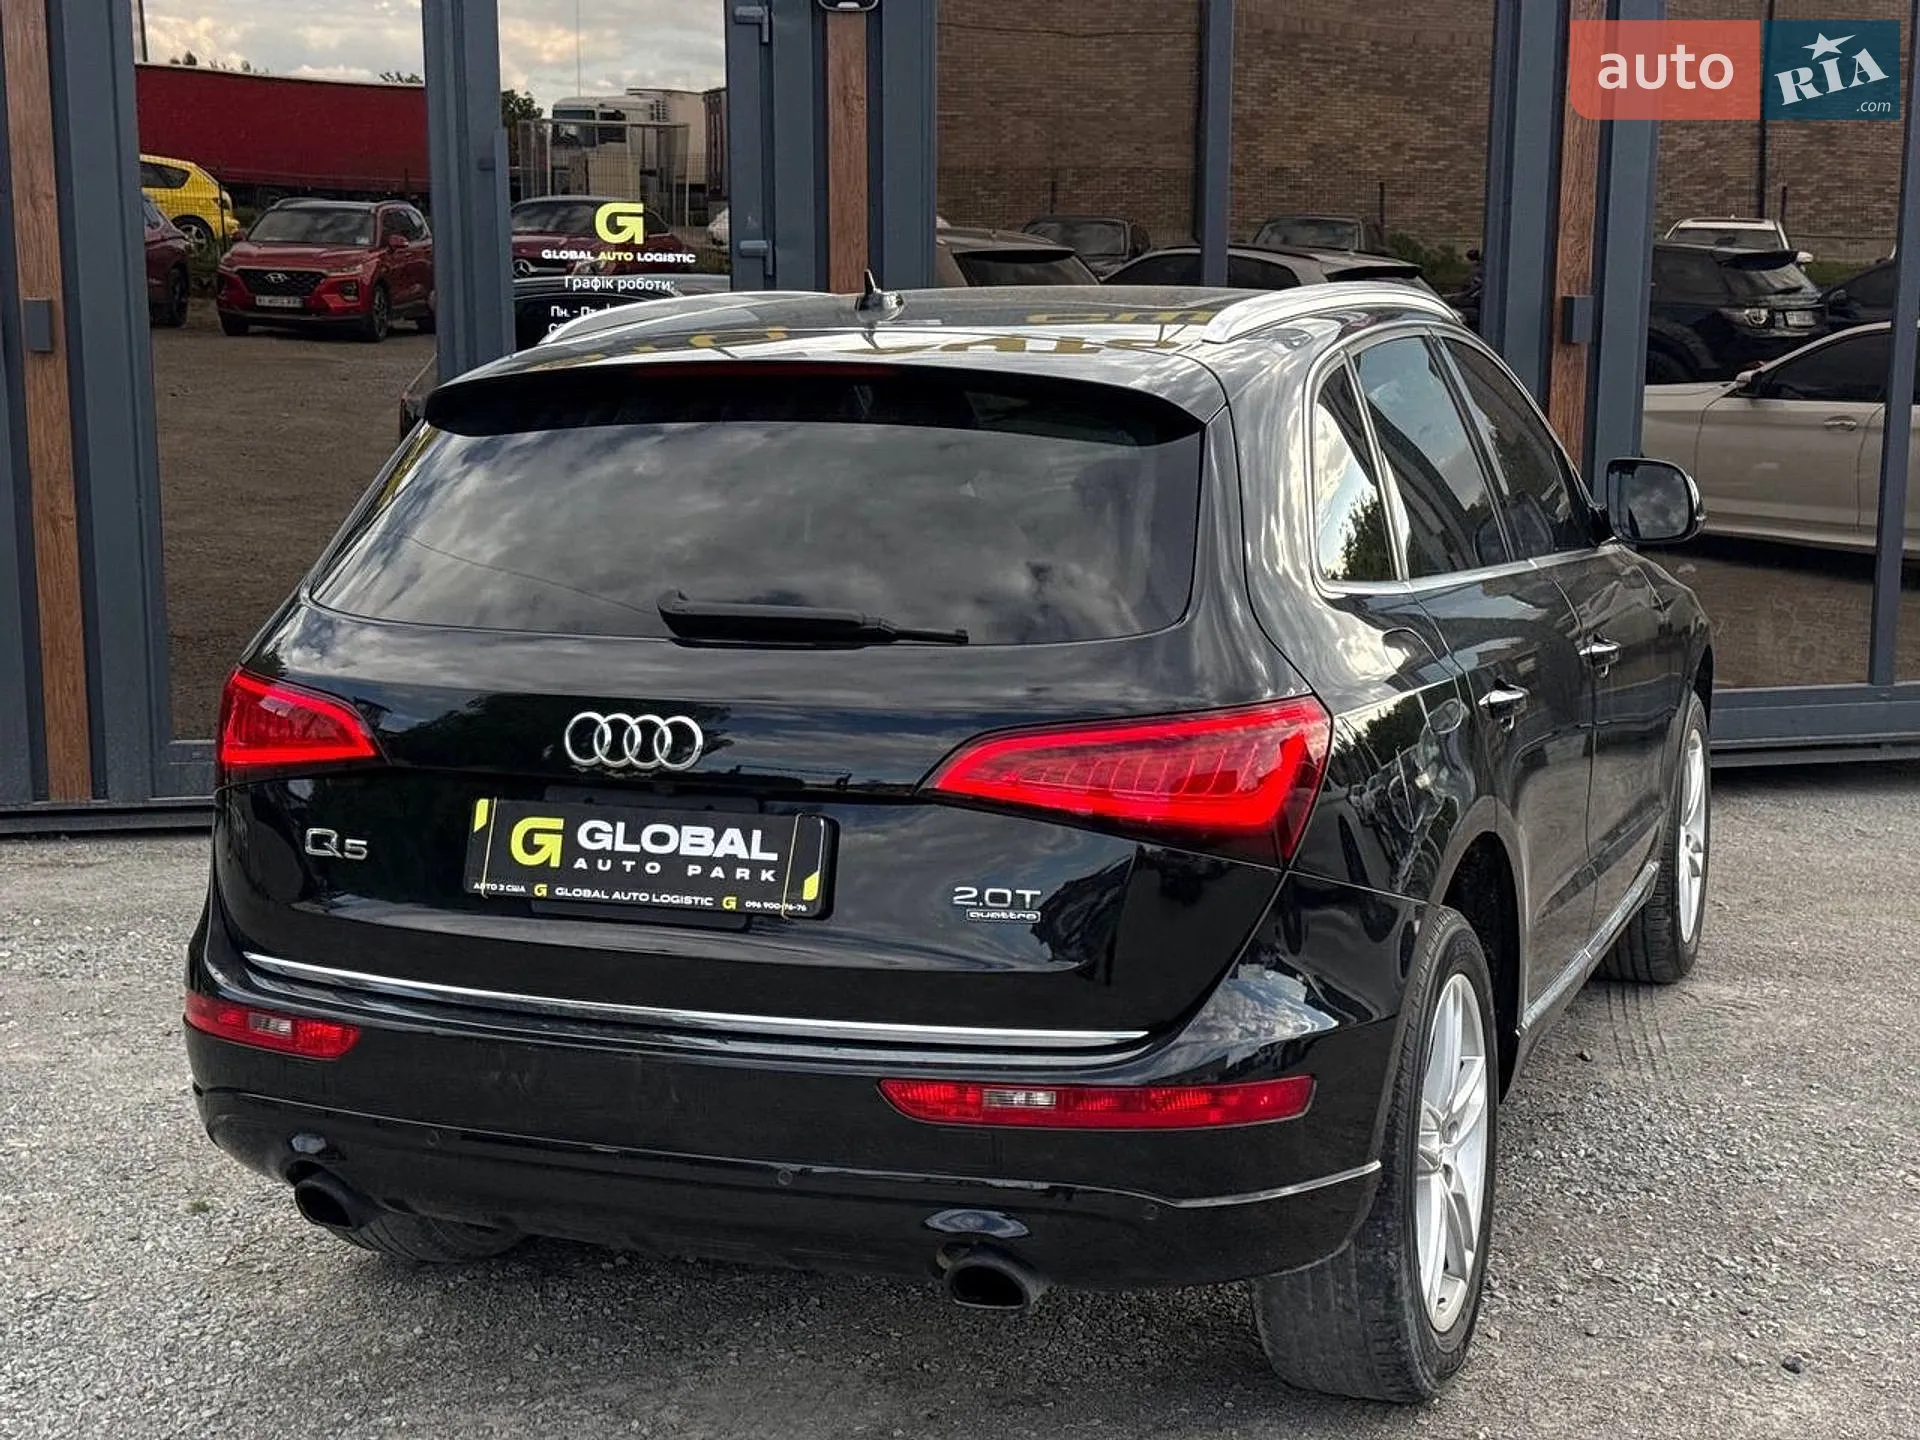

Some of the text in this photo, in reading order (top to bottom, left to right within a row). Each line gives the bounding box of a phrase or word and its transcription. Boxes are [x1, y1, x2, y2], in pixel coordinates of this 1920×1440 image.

[541, 249, 696, 263] GLOBAL AUTO LOGISTIC
[565, 277, 675, 293] Графік роботи:
[304, 828, 368, 860] Q5
[577, 819, 778, 861] GLOBAL
[573, 857, 776, 882] AUTO PARK
[555, 886, 609, 899] GLOBAL
[611, 891, 650, 902] AUTO
[652, 893, 714, 906] LOGISTIC
[953, 886, 1042, 909] 2.0T
[968, 910, 1037, 921] quattro
